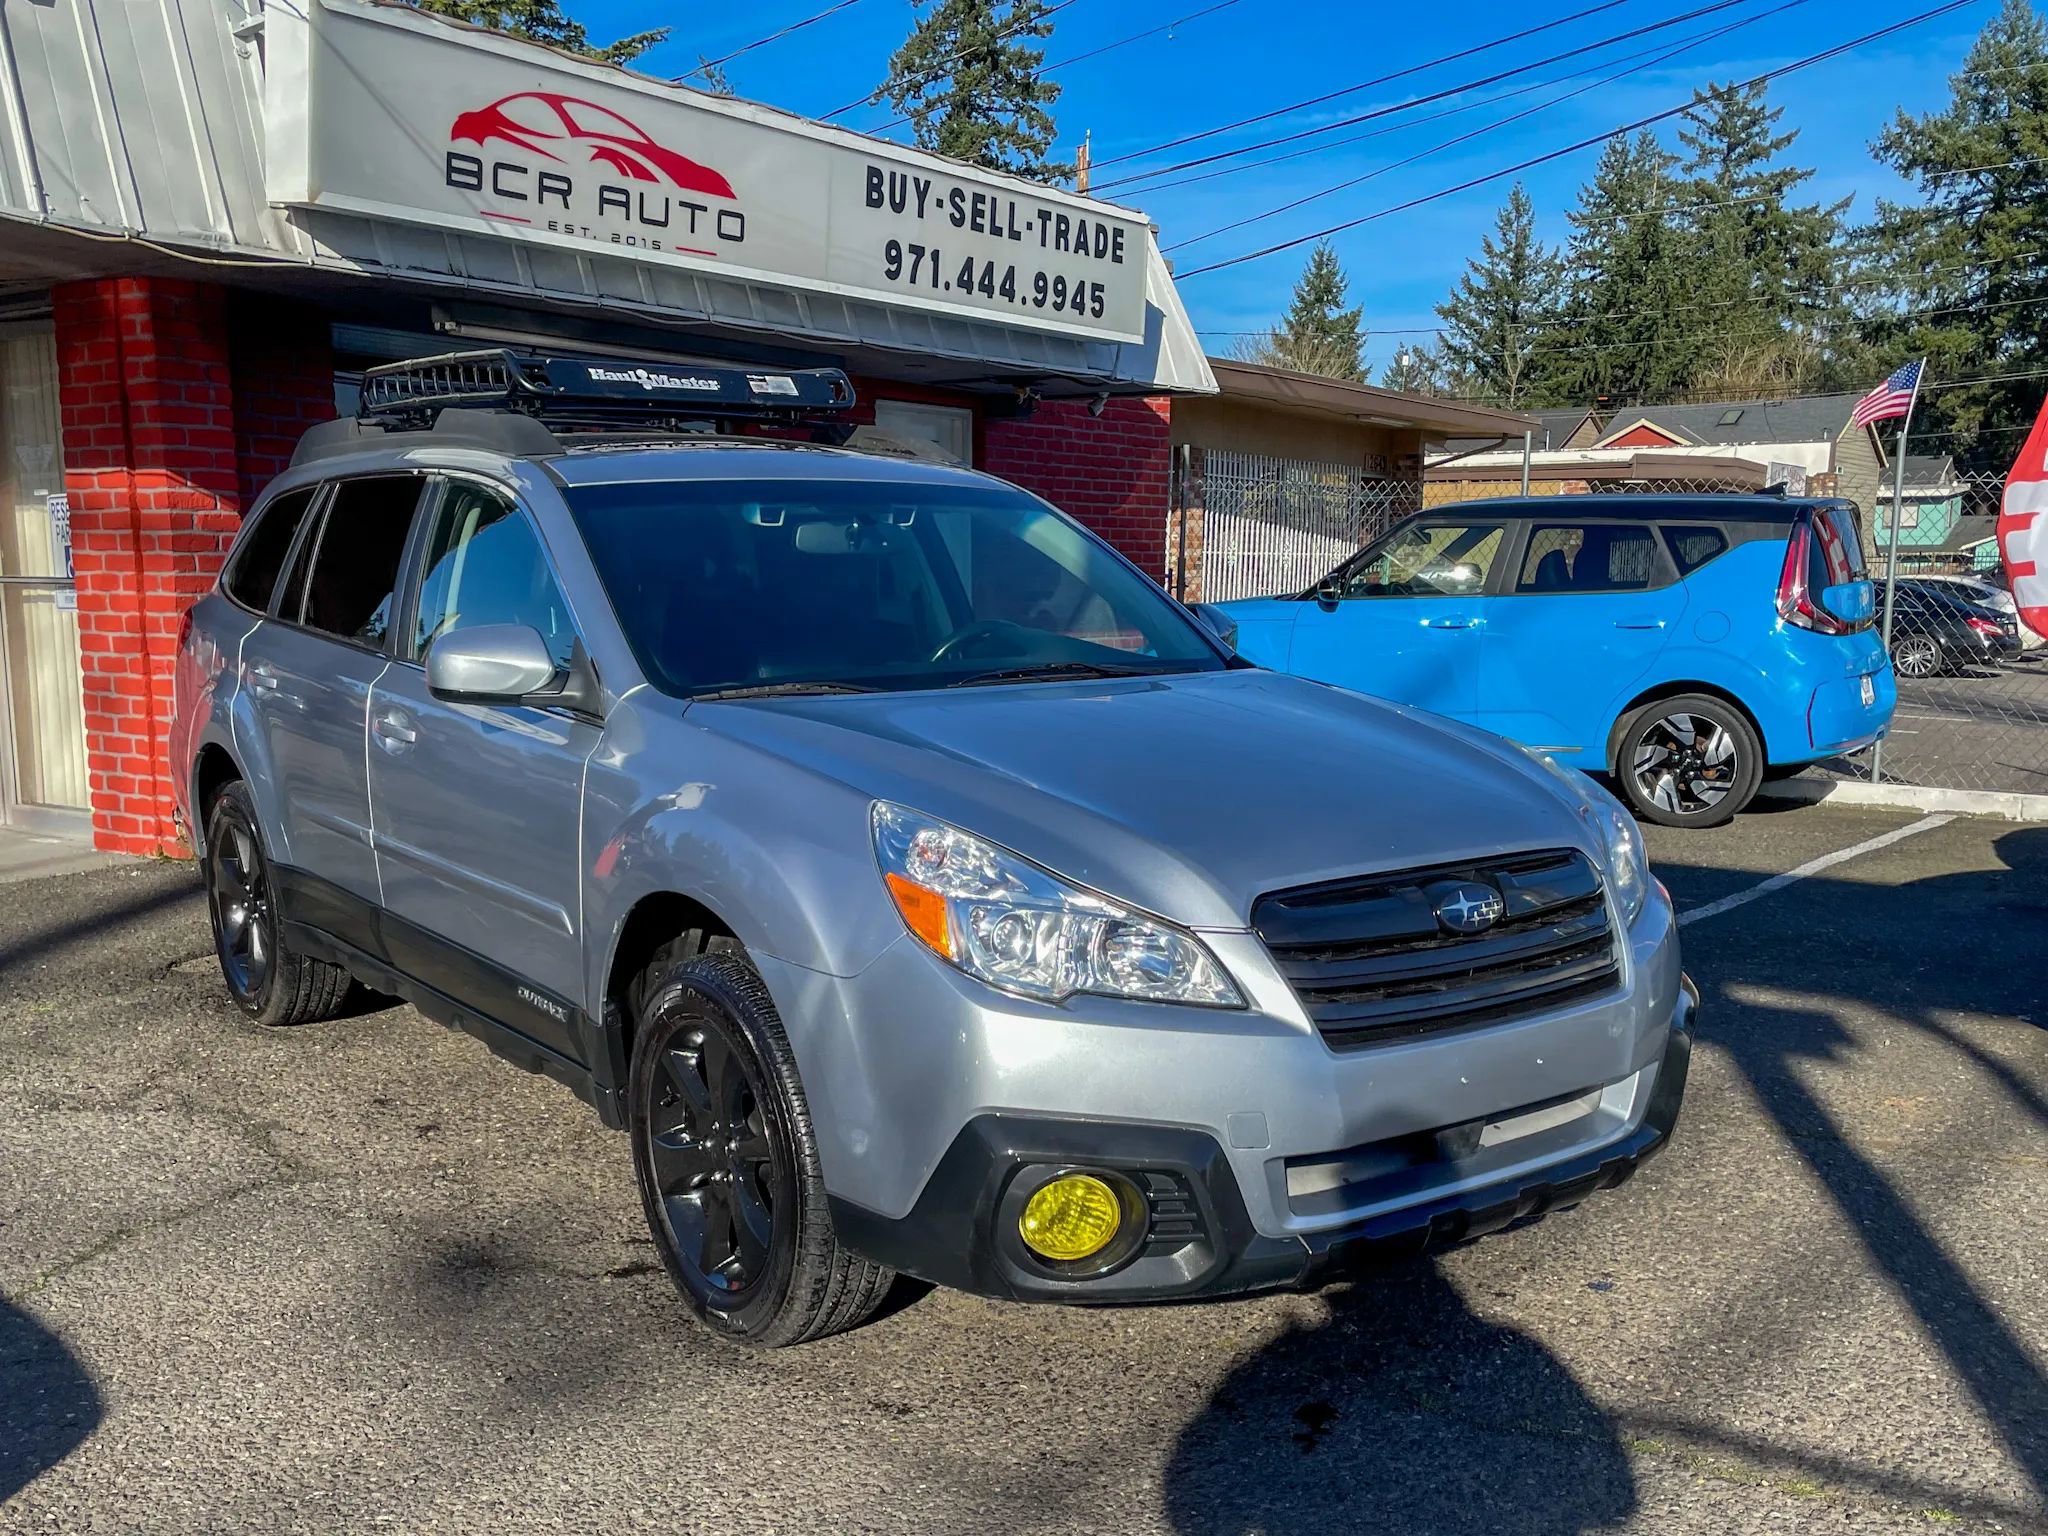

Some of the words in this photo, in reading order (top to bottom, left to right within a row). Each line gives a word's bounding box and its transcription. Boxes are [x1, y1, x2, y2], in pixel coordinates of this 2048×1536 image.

[446, 151, 573, 210] BCR
[598, 184, 746, 243] AUTO
[547, 220, 598, 240] EST.
[610, 232, 662, 251] 2015
[884, 239, 1105, 319] 971.444.9945
